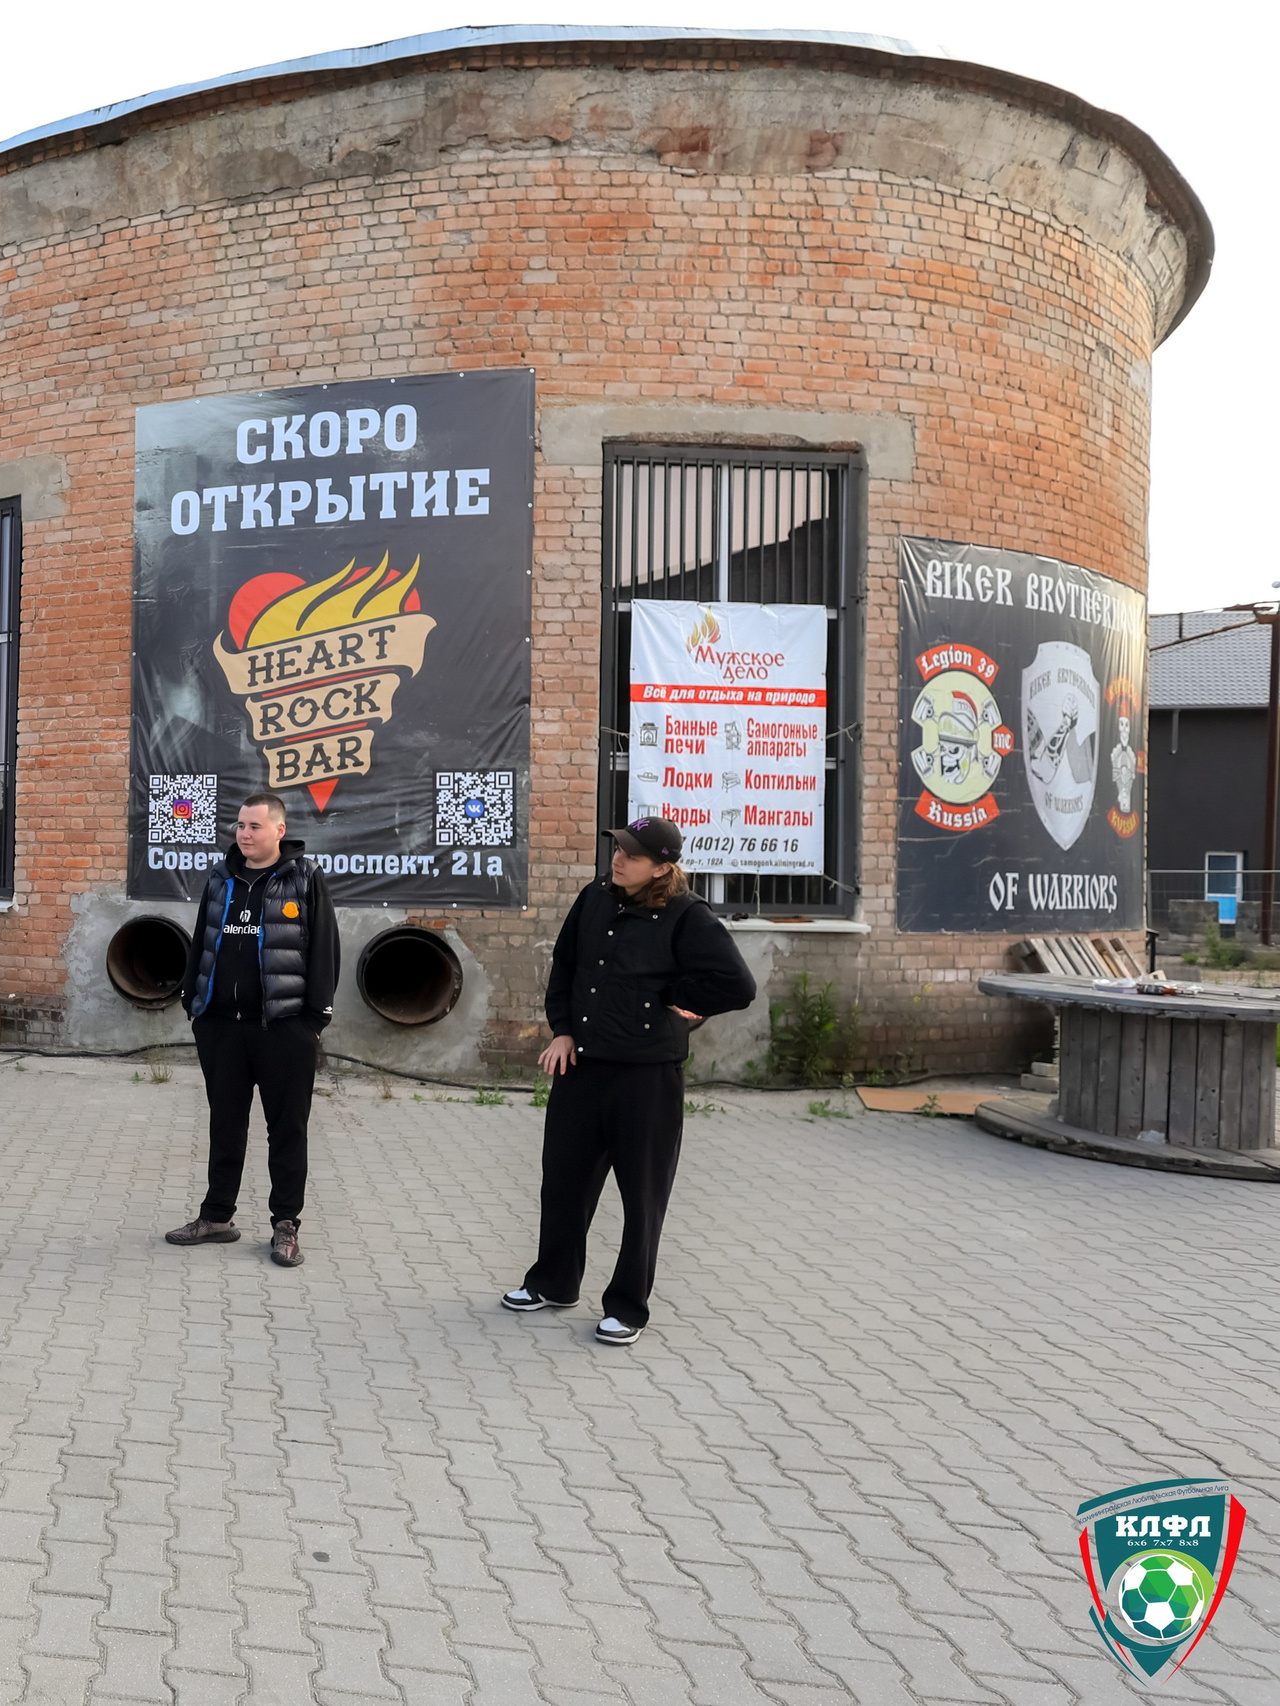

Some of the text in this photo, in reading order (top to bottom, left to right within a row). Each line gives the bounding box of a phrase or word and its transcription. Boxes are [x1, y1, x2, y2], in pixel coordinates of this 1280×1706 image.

[236, 404, 418, 464] СКОРО
[170, 468, 491, 535] ОТКРЫТИЕ
[925, 558, 1014, 607] BIKER
[247, 624, 396, 687] HEART
[695, 646, 785, 668] Мужское
[921, 645, 995, 678] Legion 39
[723, 666, 768, 684] дело
[259, 678, 381, 735] ROCK
[643, 686, 816, 705] Всё для отдыха на природе
[666, 715, 718, 736] Банные
[747, 718, 818, 740] Самогонные
[664, 739, 705, 754] печи
[747, 740, 806, 761] аппараты
[276, 737, 364, 781] BAR
[663, 767, 713, 790] Лодки
[745, 769, 816, 791] Коптильни
[662, 803, 710, 828] Нарды
[744, 805, 813, 826] Мангалы
[927, 801, 987, 827] Russia
[690, 836, 734, 854] (4012)
[740, 838, 756, 852] 76
[761, 838, 777, 852] 66
[784, 839, 798, 852] 16
[148, 847, 226, 871] Совет
[451, 851, 503, 876] 21а
[989, 872, 1117, 913] OF WARRIORS
[223, 924, 261, 936] alenciag
